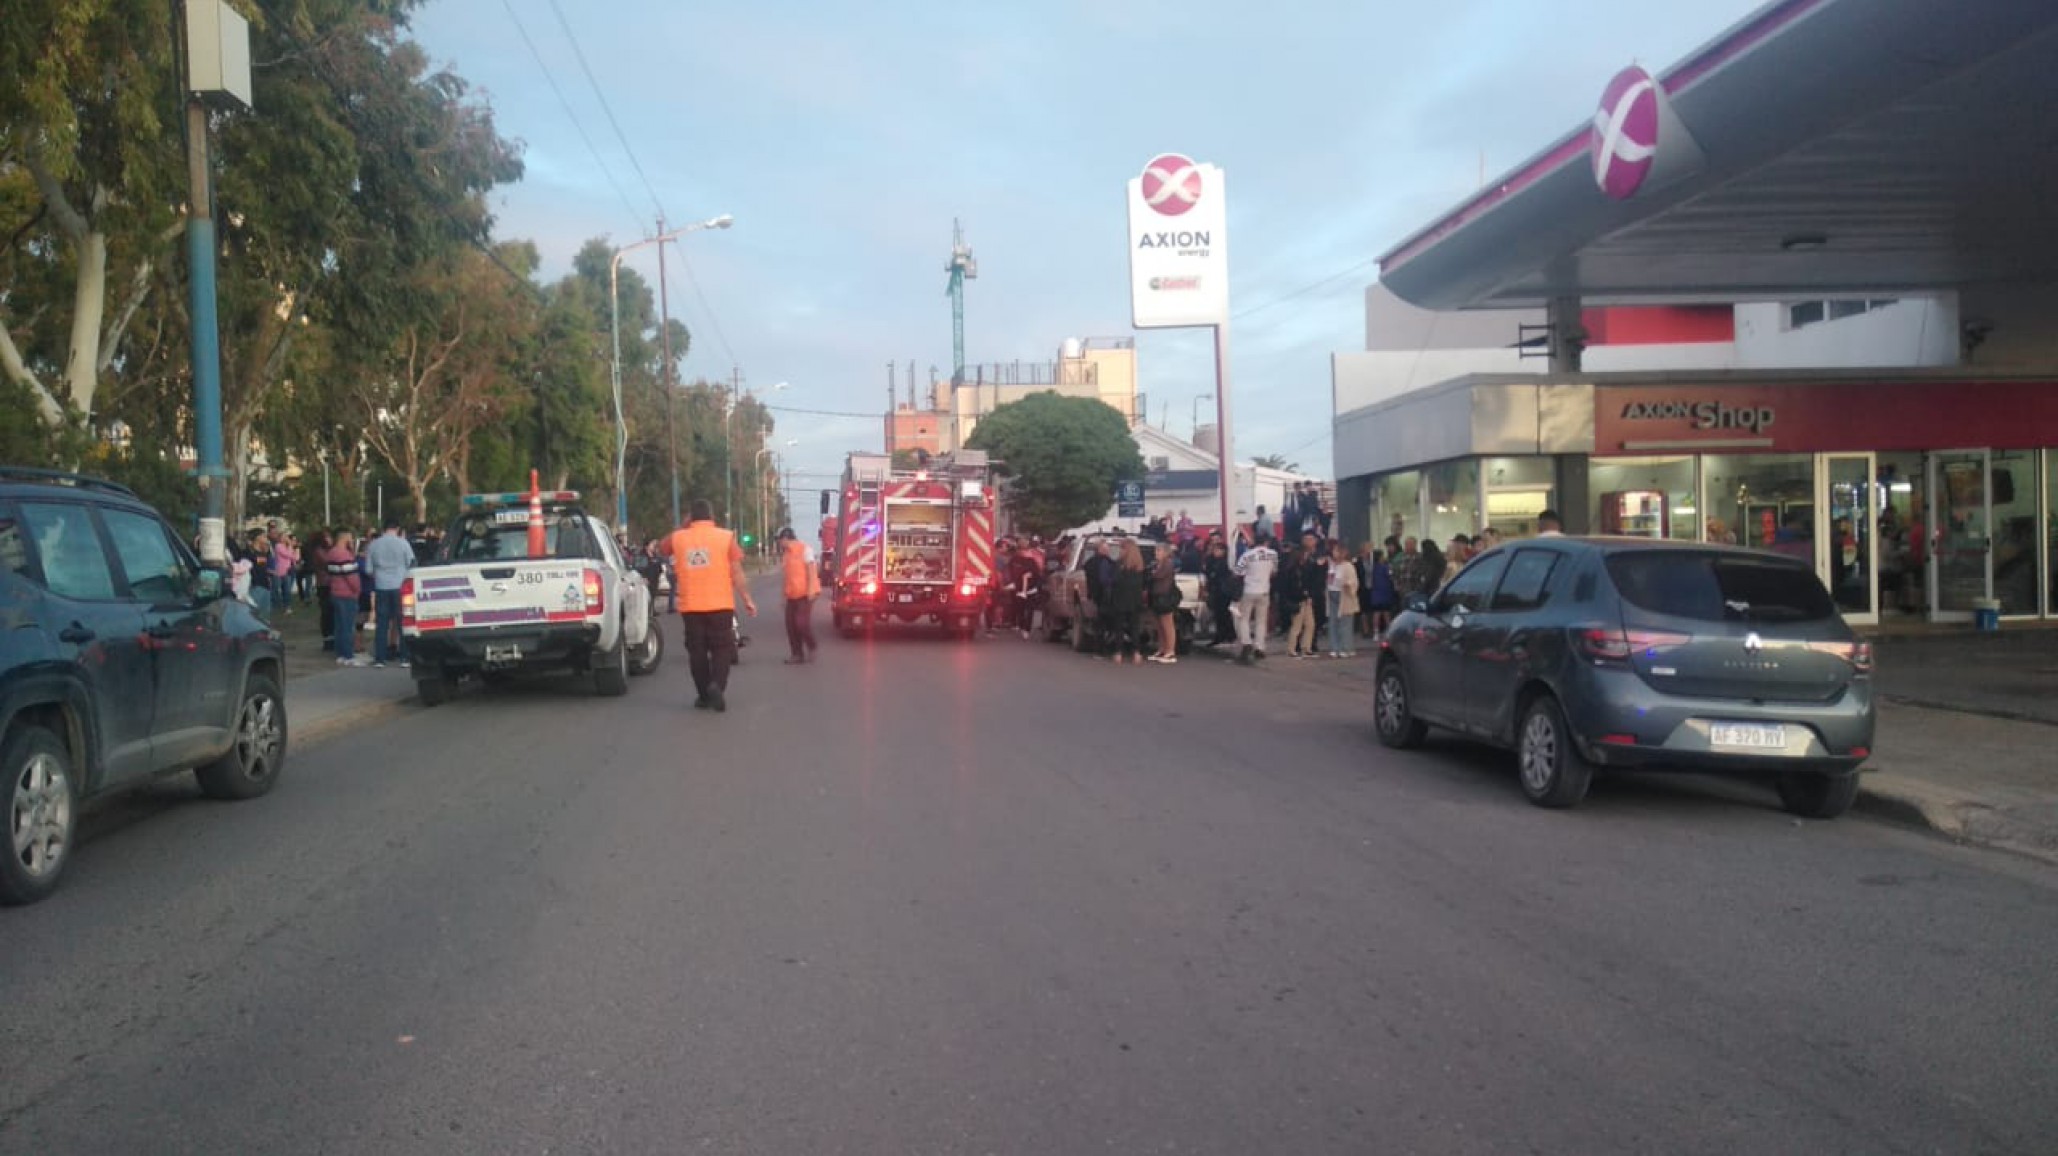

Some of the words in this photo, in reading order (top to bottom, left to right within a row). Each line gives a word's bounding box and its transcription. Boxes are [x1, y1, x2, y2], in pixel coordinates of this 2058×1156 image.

[1139, 231, 1210, 249] AXION
[1621, 402, 1690, 419] AXION
[1691, 400, 1775, 434] Shop
[517, 571, 543, 585] 380
